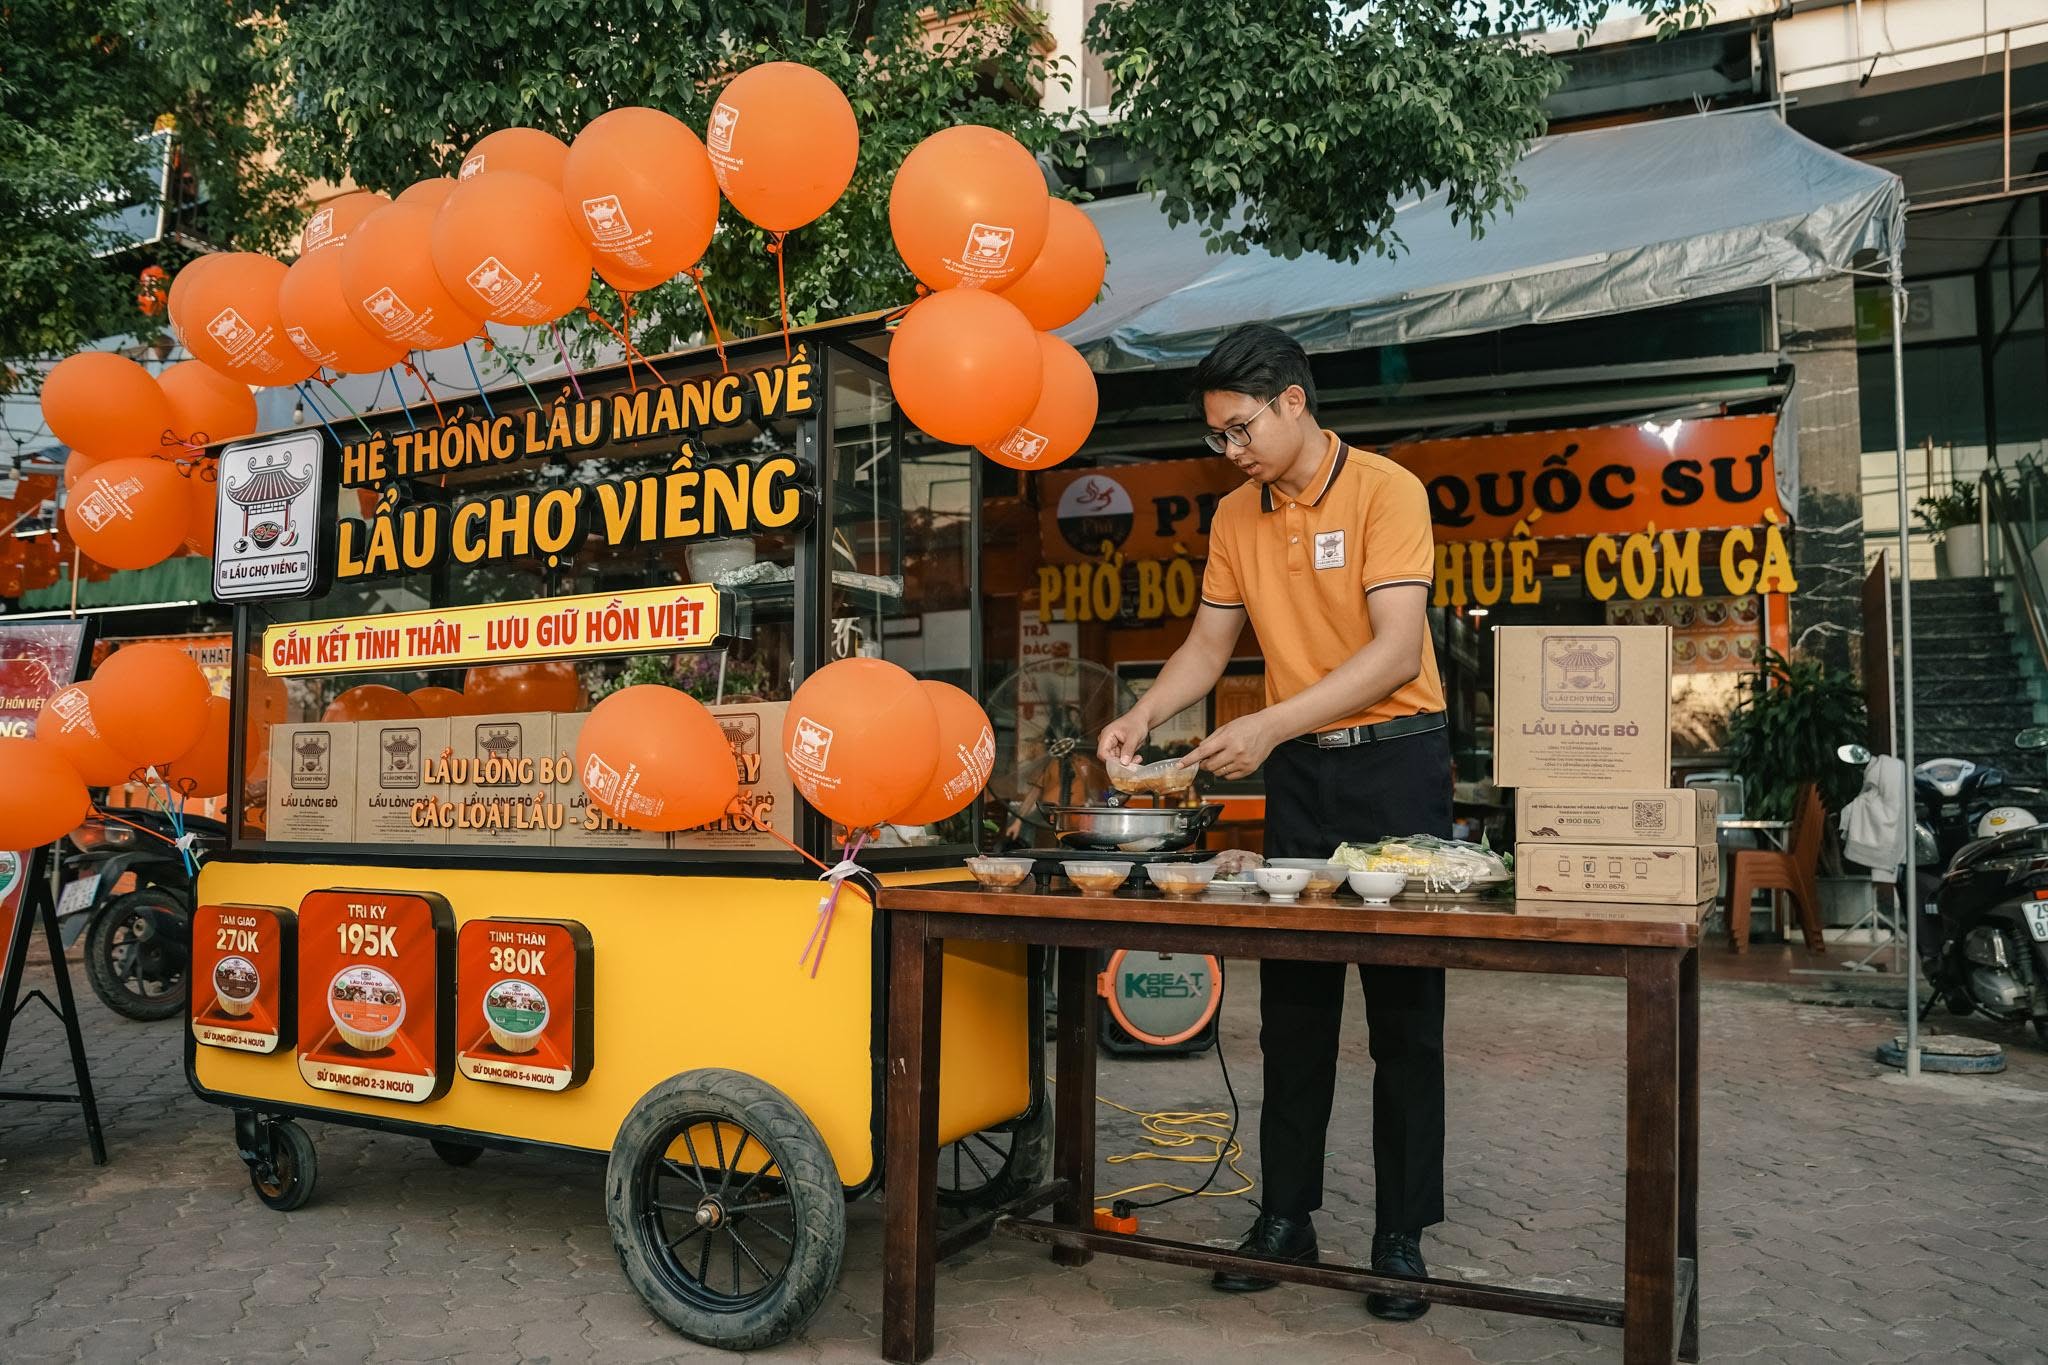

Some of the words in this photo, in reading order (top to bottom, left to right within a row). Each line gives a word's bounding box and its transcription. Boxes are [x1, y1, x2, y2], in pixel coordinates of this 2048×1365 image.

[343, 431, 386, 489] HỆ
[393, 406, 515, 475] THỐNG
[526, 385, 601, 454] LẨU
[613, 376, 742, 440] MANG
[753, 344, 812, 416] VỀ
[1427, 443, 1636, 527] QUỐC
[1660, 444, 1771, 506] SƯ
[337, 488, 437, 578] LẨU
[452, 487, 582, 568] CHỢ
[596, 443, 800, 546] VIỀNG
[249, 564, 269, 578] CHỢ
[1432, 507, 1543, 607] HUẾ
[1584, 520, 1703, 601] CƠM
[1719, 507, 1798, 596] GÀ
[1038, 539, 1124, 622] PHỞ
[1137, 542, 1195, 619] BÒ
[272, 629, 311, 666] GẮN
[317, 624, 350, 663] KẾT
[355, 625, 400, 661] TÌNH
[406, 618, 461, 657] THÂN
[487, 615, 529, 651] LƯU
[536, 608, 579, 647] GIỮ
[586, 598, 640, 643] HỒN
[648, 596, 704, 641] VIỆT
[1522, 717, 1556, 736] LẨU
[1560, 720, 1610, 737] LÒNG
[1613, 720, 1639, 737] BÒ
[424, 747, 468, 785] LẨU
[472, 751, 534, 785] LÒNG
[539, 751, 573, 785] BÒ
[281, 793, 297, 807] LẨU
[300, 796, 323, 807] LÒNG
[326, 796, 338, 807] BÒ
[369, 793, 387, 808] LẨU
[389, 796, 414, 807] LÒNG
[411, 795, 455, 828] CÁC
[458, 803, 510, 836] LOẠI
[516, 791, 563, 830] LẨU
[347, 904, 367, 919] TRI
[216, 927, 260, 953] 270K
[337, 923, 399, 958] 195K
[489, 946, 546, 976] 380K
[317, 1068, 328, 1081] SỬ
[329, 1073, 351, 1086] DỤNG
[352, 1075, 370, 1087] CHO
[371, 1079, 385, 1089] 2-3
[386, 1080, 414, 1093] NGƯỜI
[483, 1067, 502, 1078] DỤNG
[503, 1069, 518, 1079] CHO
[519, 1071, 531, 1081] 5-6
[532, 1073, 555, 1085] NGƯỜI
